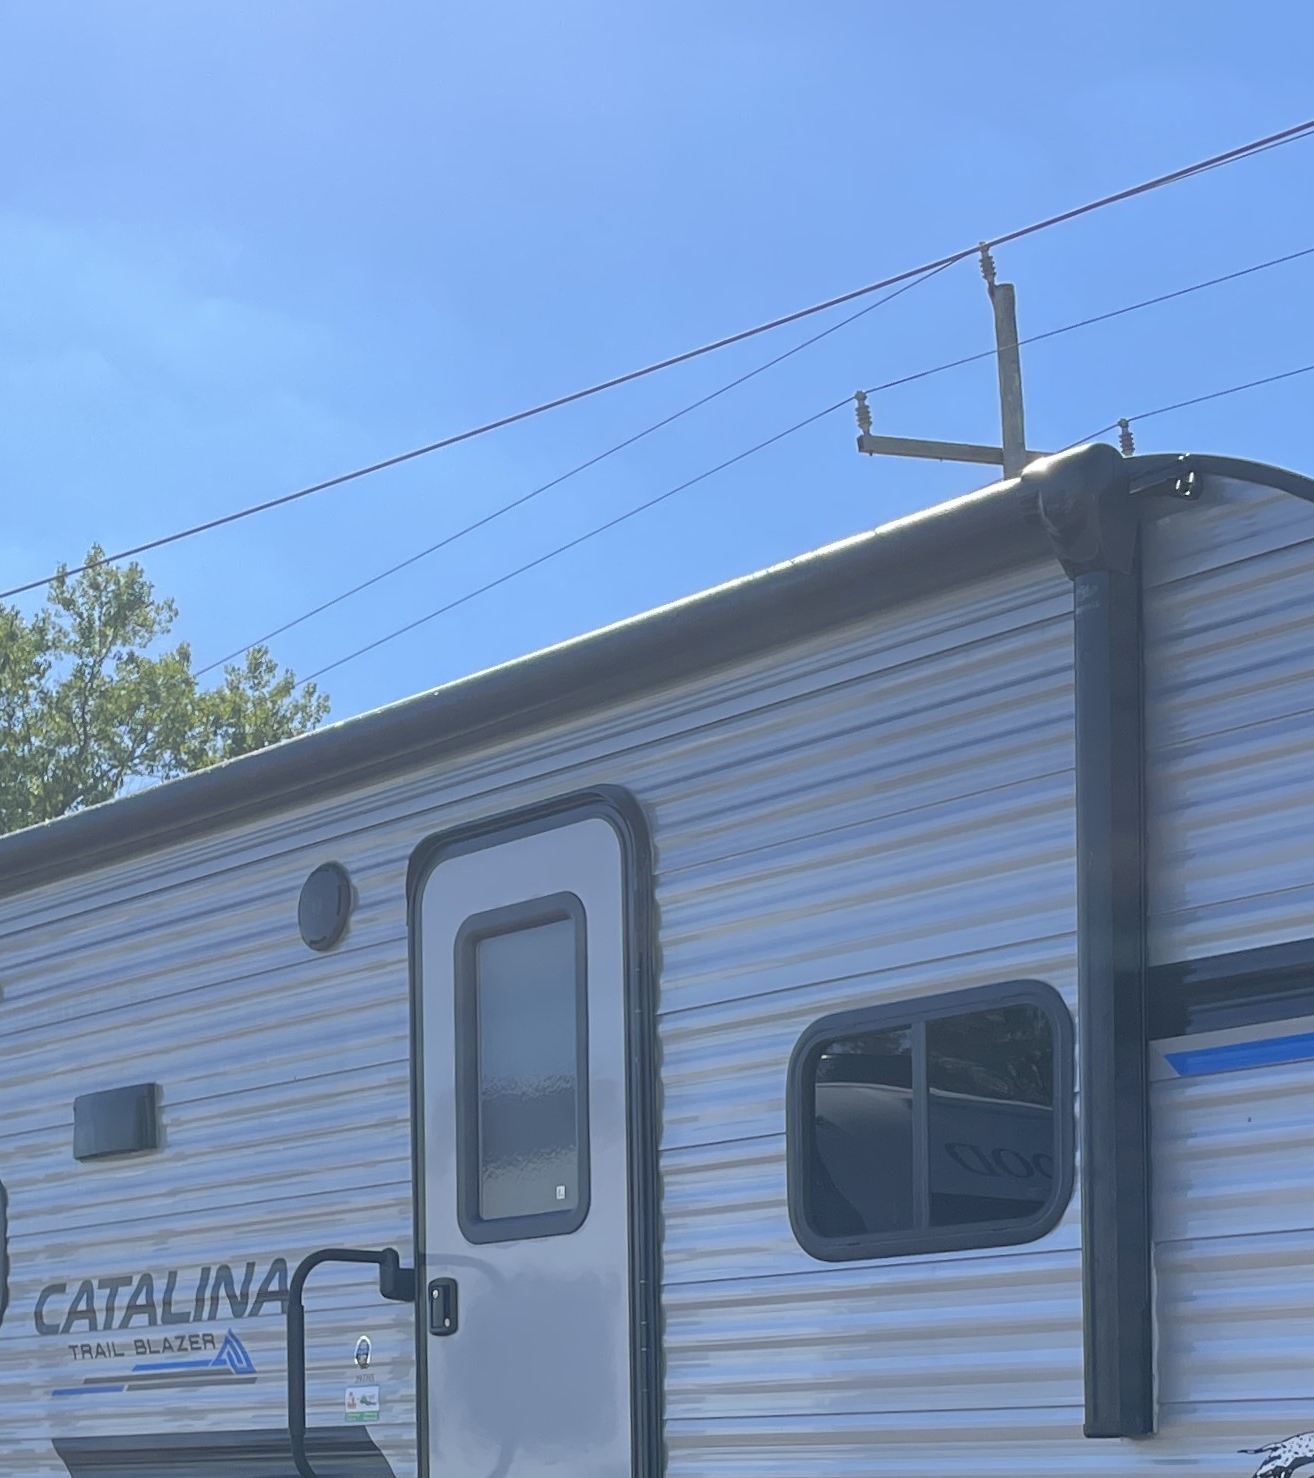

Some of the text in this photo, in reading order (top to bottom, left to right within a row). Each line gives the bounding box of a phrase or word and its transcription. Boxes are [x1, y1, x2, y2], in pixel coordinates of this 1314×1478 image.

[34, 1257, 289, 1335] CATALINA
[68, 1333, 216, 1360] TRAIL BLAZER
